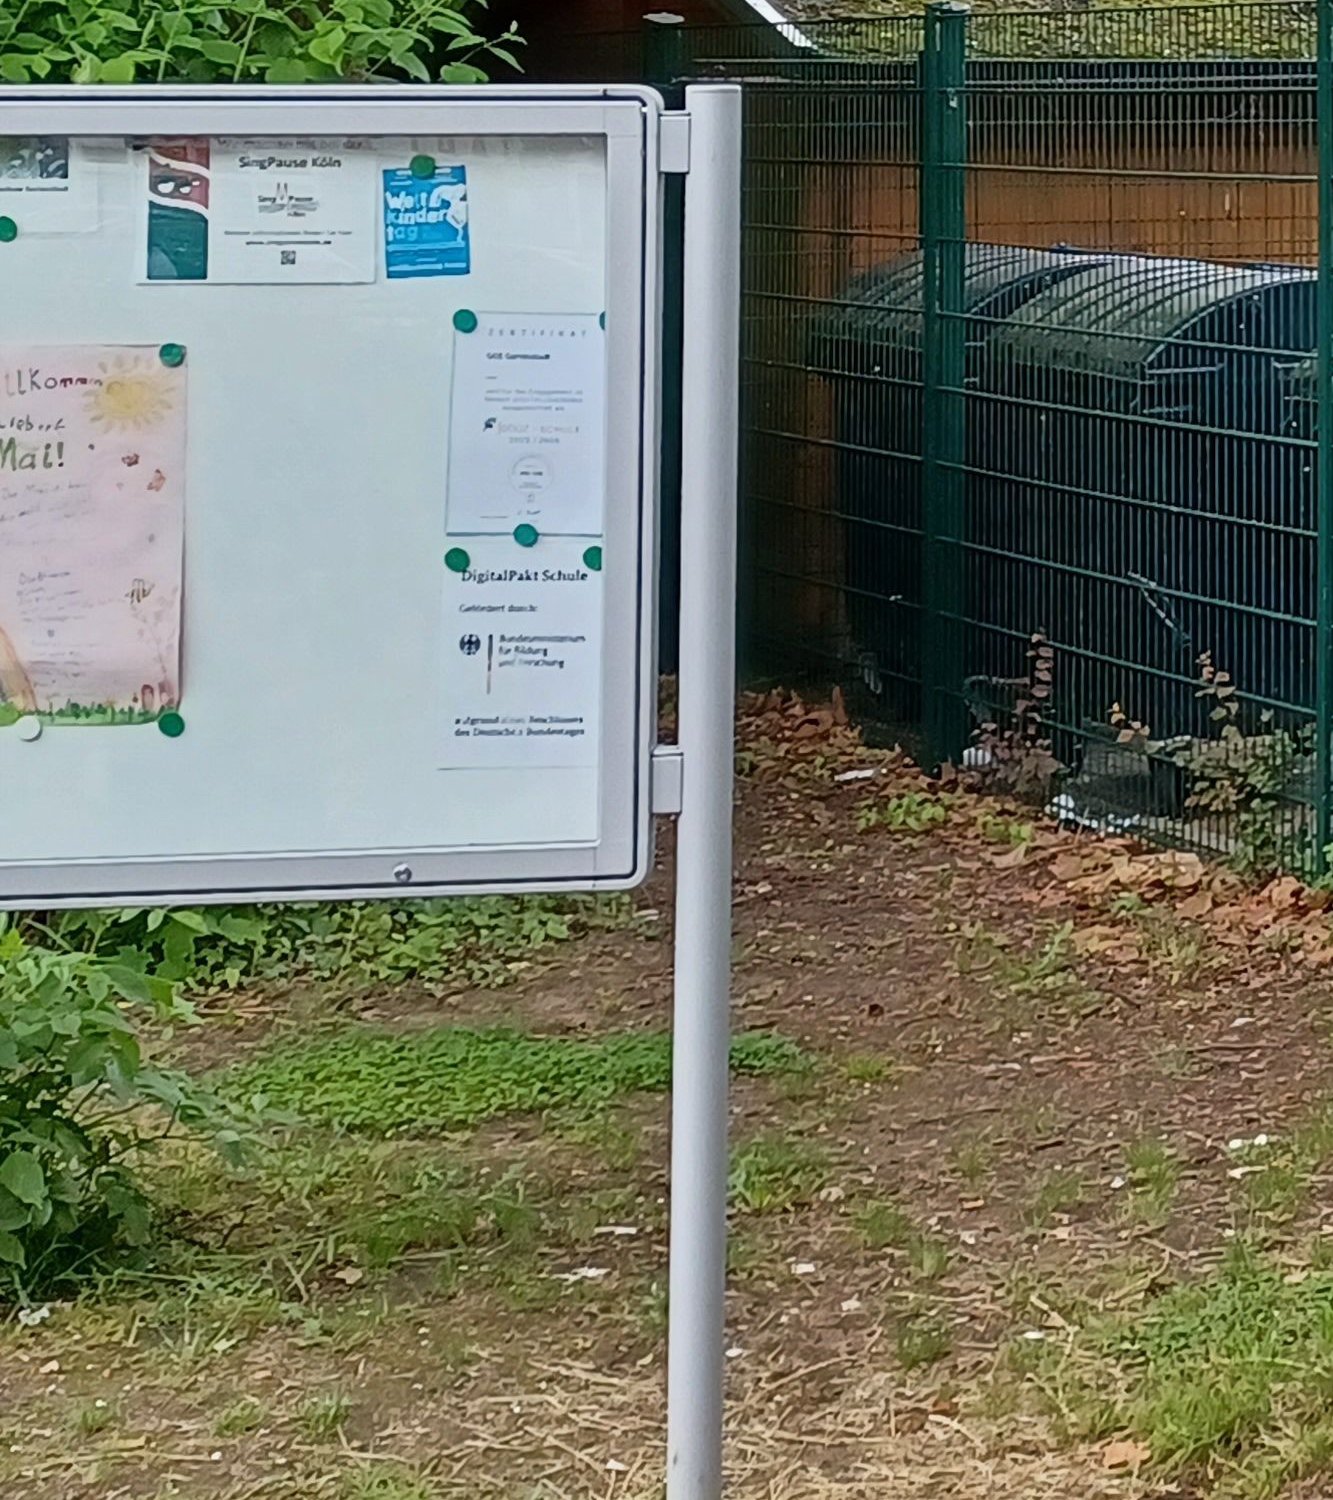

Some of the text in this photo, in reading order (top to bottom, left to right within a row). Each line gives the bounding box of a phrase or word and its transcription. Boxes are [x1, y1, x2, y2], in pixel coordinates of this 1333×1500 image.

[238, 156, 342, 170] SingPause Köln
[461, 569, 589, 584] DigitalPakt Schule
